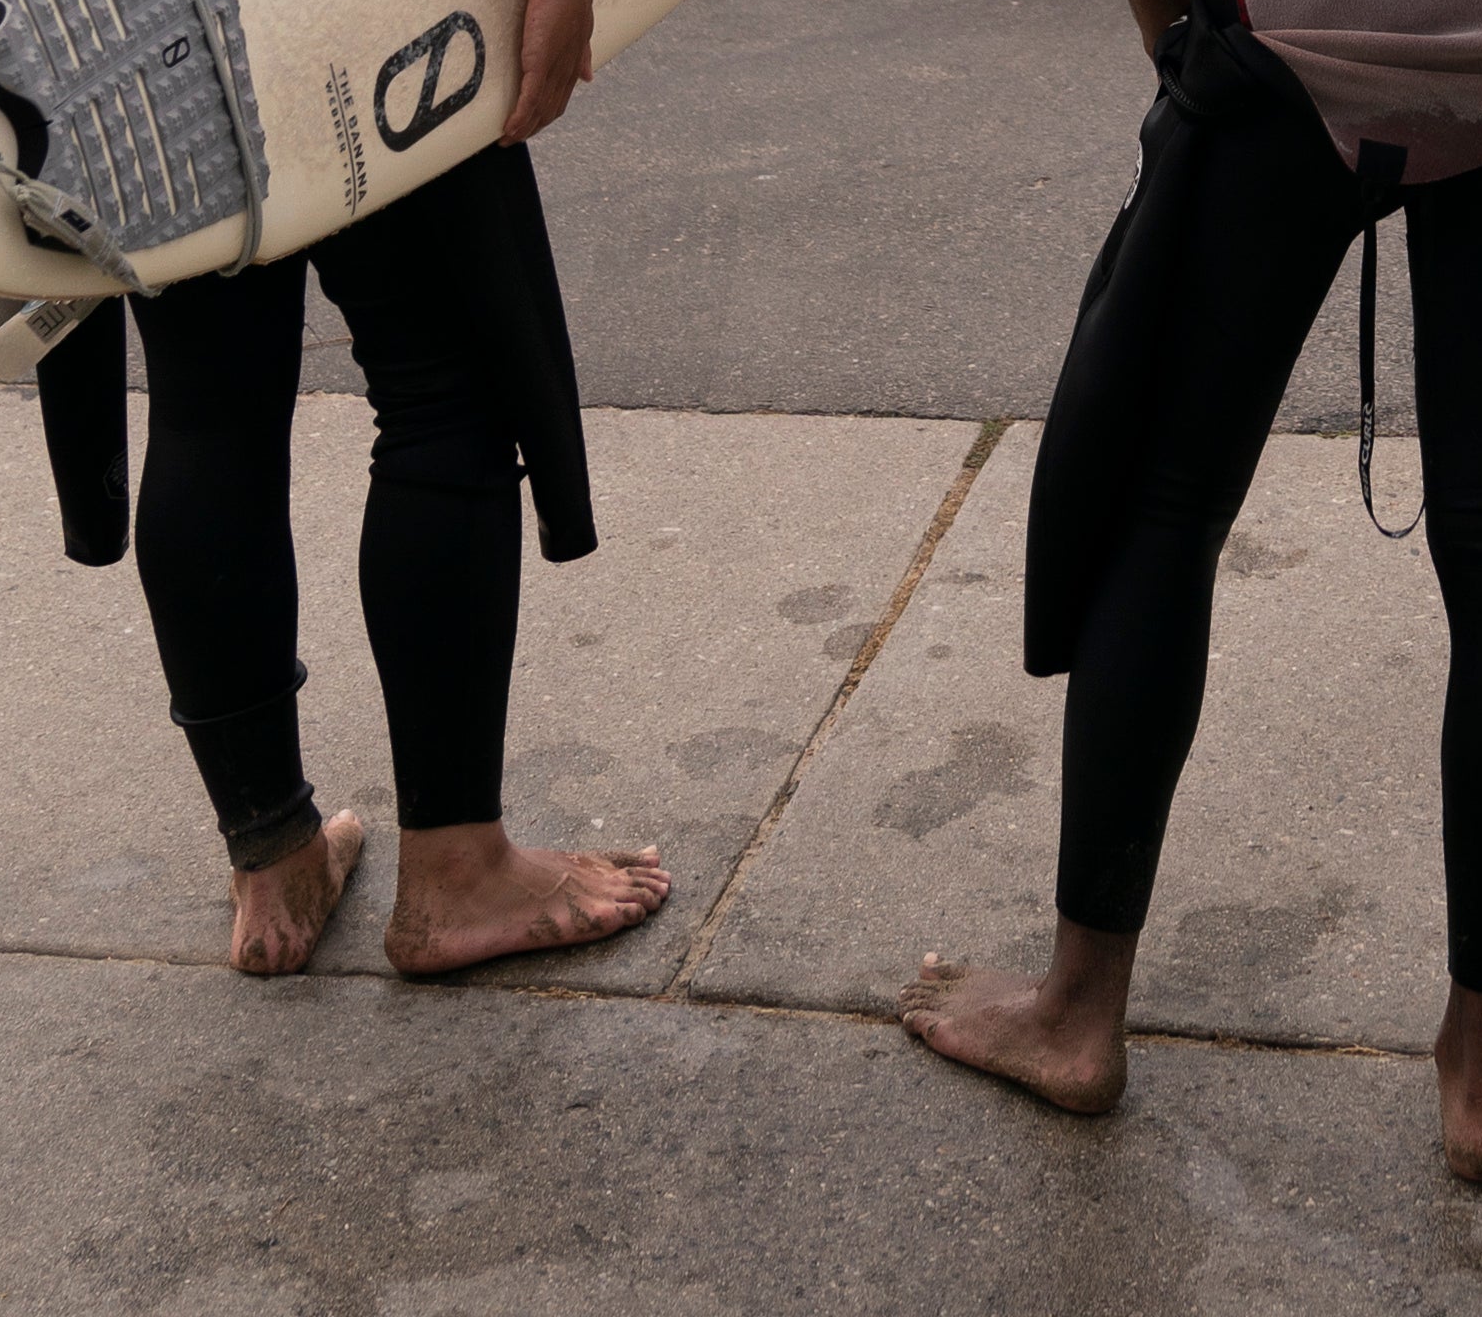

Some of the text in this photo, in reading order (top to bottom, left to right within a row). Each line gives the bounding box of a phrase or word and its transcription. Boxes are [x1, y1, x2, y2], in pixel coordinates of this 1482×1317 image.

[325, 80, 346, 153] WEBBER
[344, 177, 352, 207] FST
[338, 67, 367, 203] THE BANANA
[1361, 415, 1373, 465] CURL
